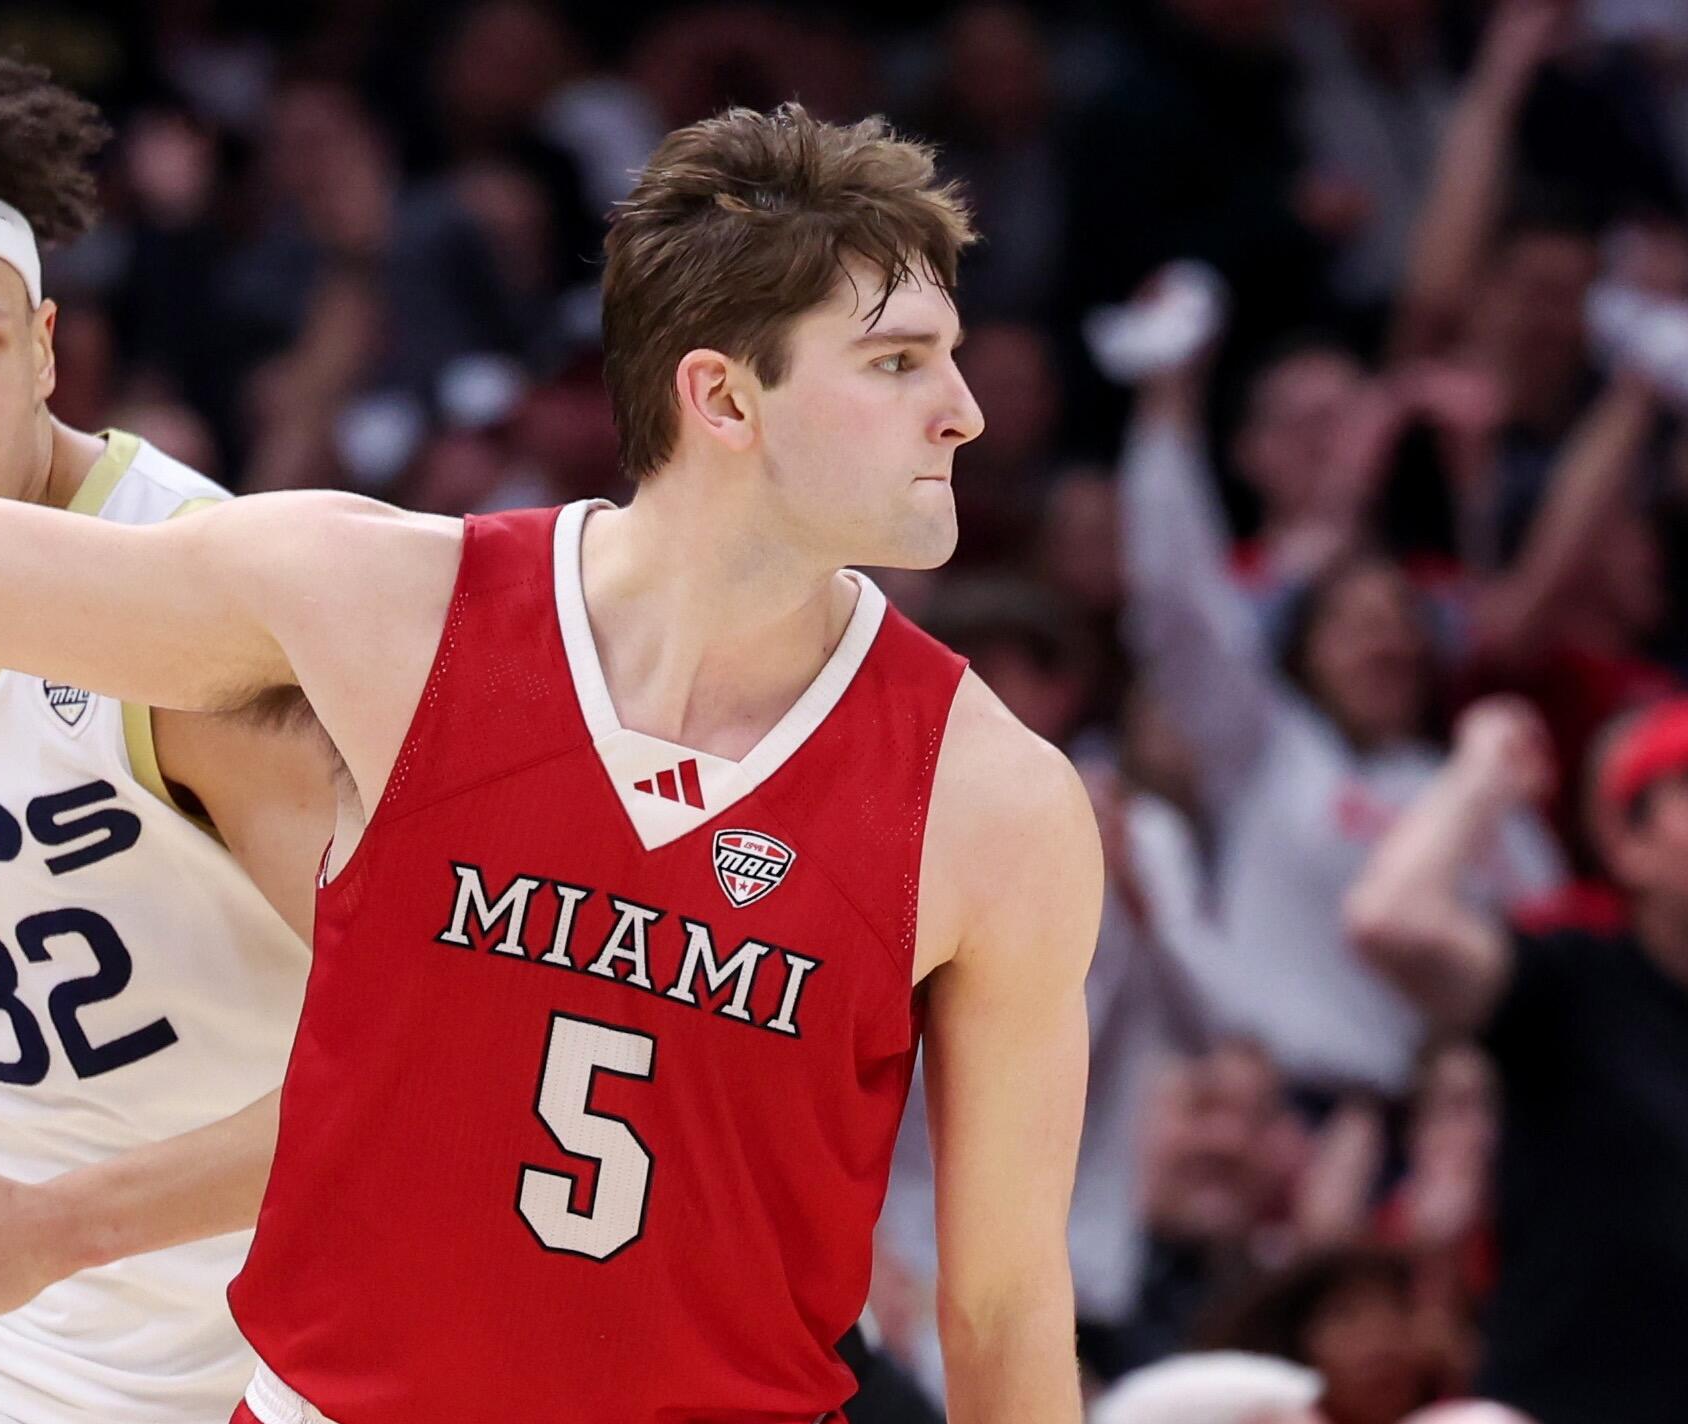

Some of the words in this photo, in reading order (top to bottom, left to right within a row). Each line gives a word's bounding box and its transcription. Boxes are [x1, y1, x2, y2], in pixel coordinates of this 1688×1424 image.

[434, 860, 824, 1040] MIAMI
[715, 848, 785, 882] MAC
[514, 1010, 657, 1264] 5
